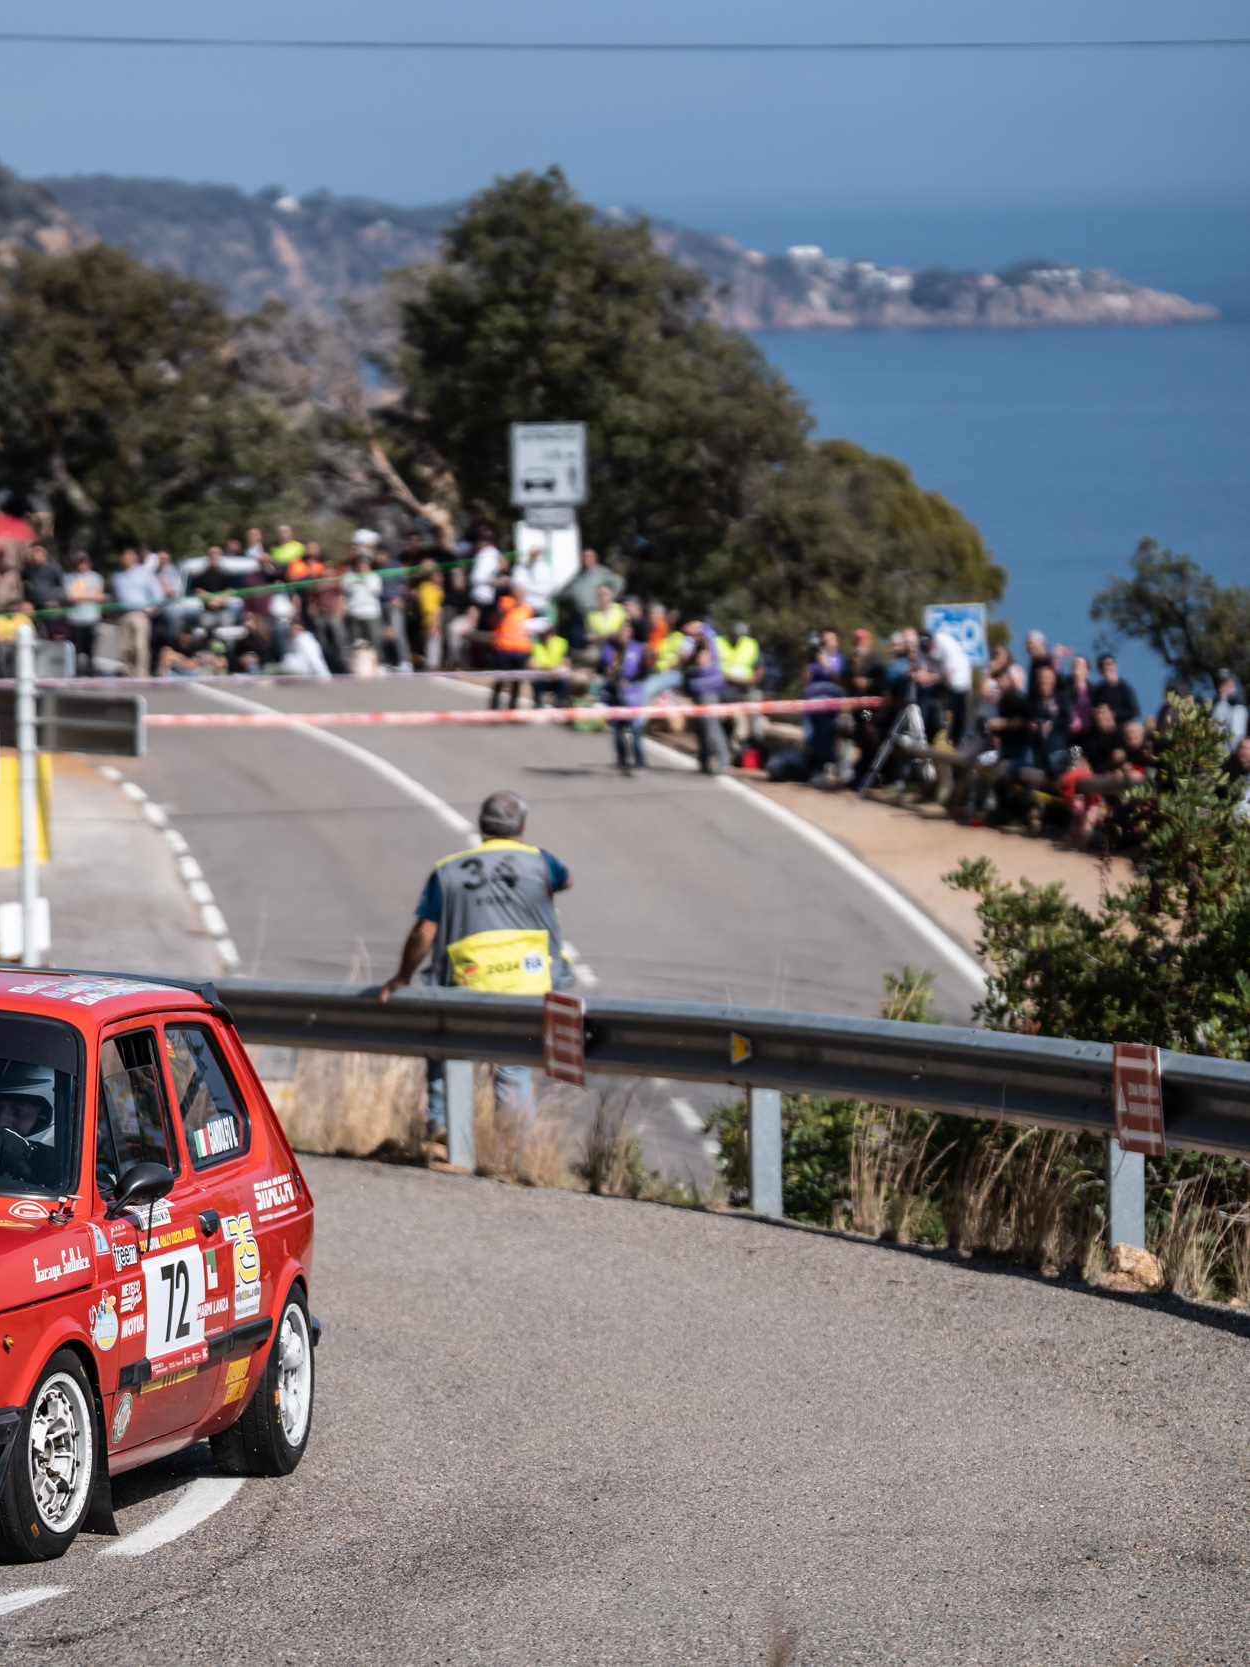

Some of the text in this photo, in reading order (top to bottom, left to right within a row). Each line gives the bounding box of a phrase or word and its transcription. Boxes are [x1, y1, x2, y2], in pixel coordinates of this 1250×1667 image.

[486, 961, 520, 974] 2024
[33, 1257, 62, 1282] Garage
[112, 1242, 137, 1272] freem
[121, 1280, 141, 1298] METECO
[160, 1260, 190, 1343] 72
[197, 1297, 229, 1319] MARMI LANZA
[121, 1314, 145, 1339] MOTUL
